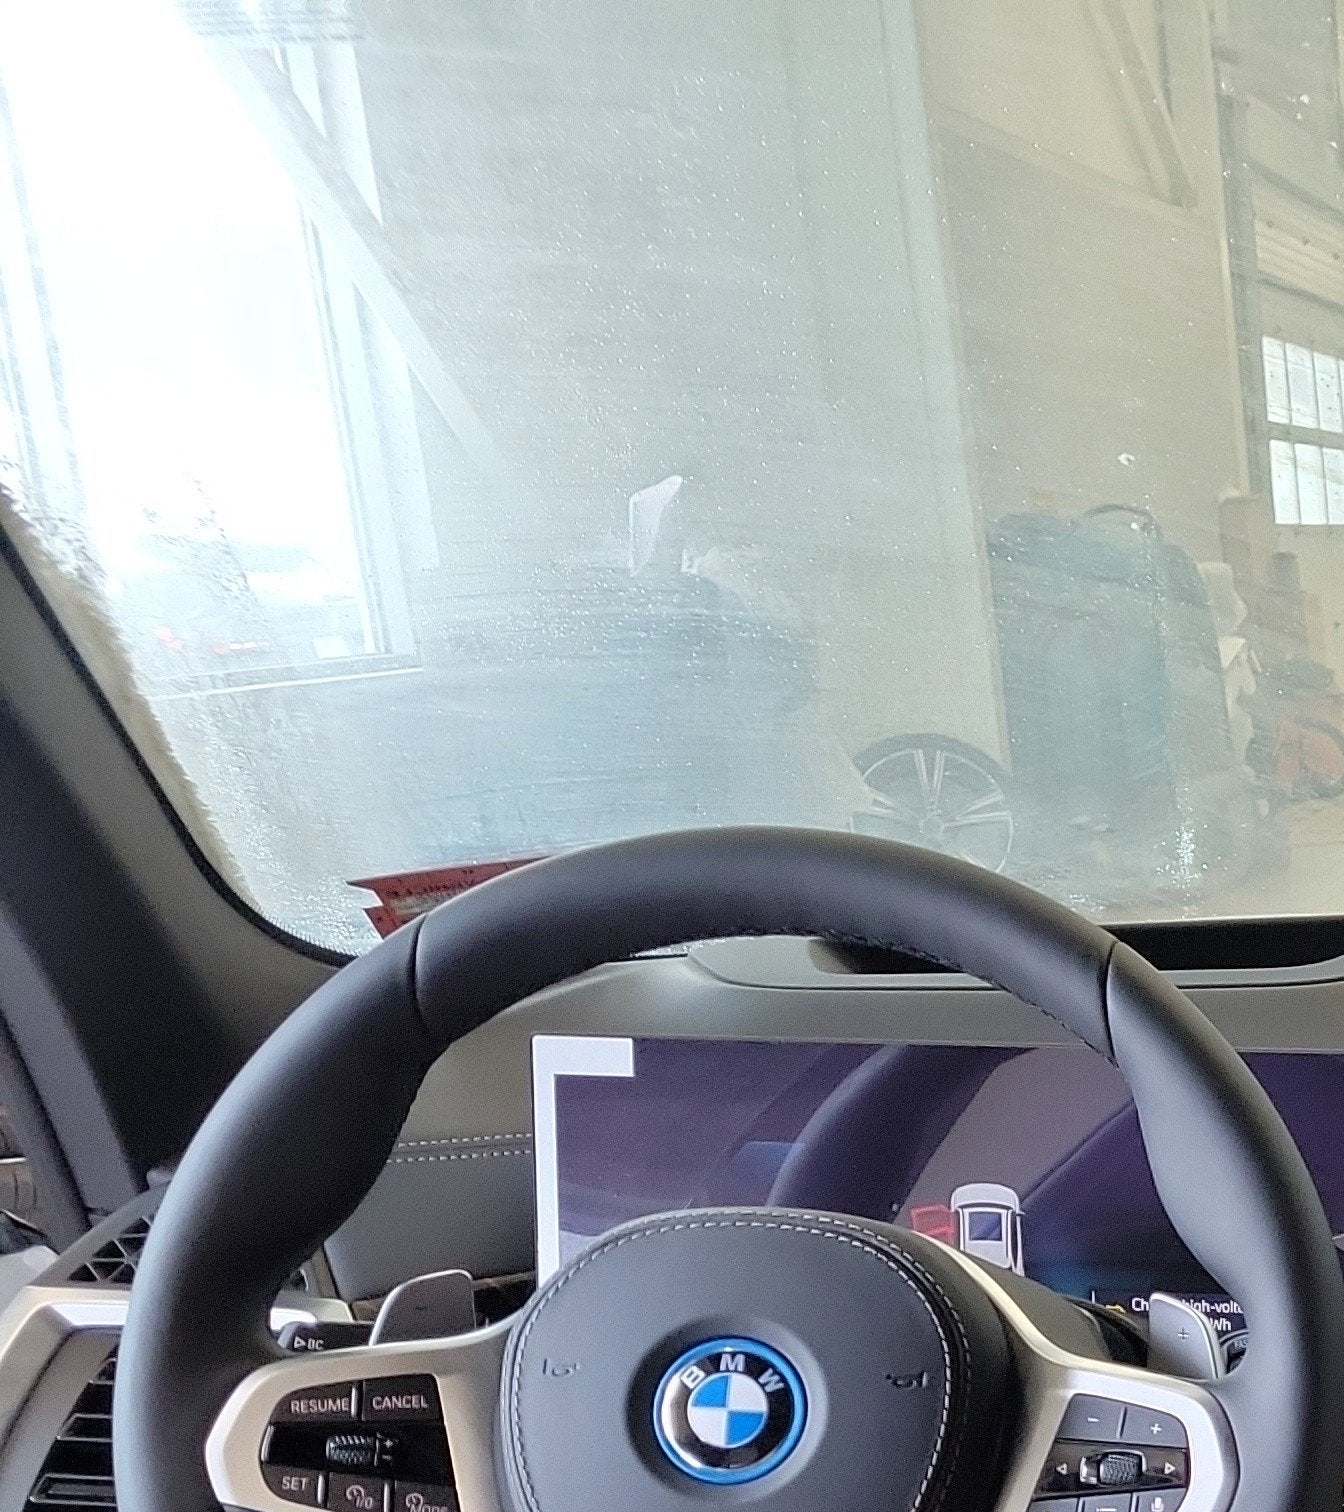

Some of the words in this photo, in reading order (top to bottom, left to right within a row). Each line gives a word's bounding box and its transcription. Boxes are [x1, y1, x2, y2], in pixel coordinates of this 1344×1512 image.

[681, 1353, 785, 1393] BMW
[290, 1397, 350, 1414] RESUME
[372, 1395, 428, 1410] CANCEL
[281, 1476, 308, 1491] SET
